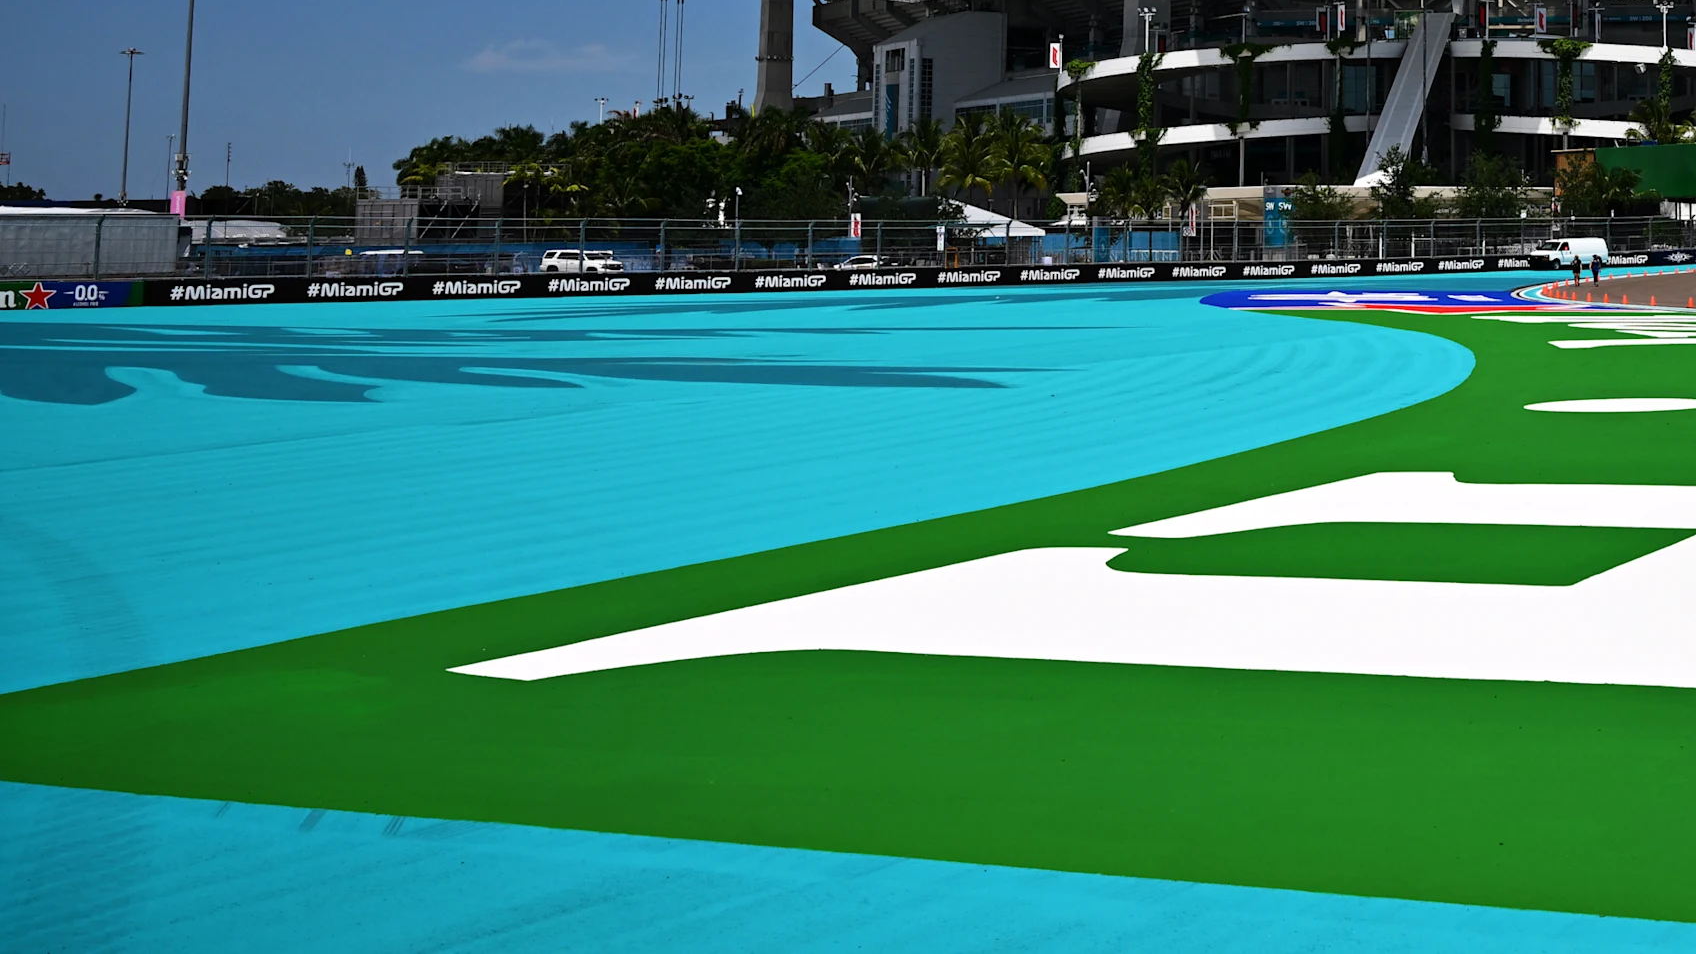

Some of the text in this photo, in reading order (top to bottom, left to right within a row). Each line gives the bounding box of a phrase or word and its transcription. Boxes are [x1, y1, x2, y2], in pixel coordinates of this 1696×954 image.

[1265, 201, 1276, 211] SW
[1243, 265, 1295, 275] #MiamiGP
[1311, 263, 1361, 274] #MiamiGP
[1376, 262, 1424, 272] #MiamiGP
[1438, 260, 1484, 270] #MiamiGP
[938, 271, 1000, 282] #MiamiGP
[1020, 269, 1080, 280] #MiamiGP
[1098, 267, 1155, 278] #MiamiGP
[1172, 266, 1226, 277] #MiamiGP
[548, 278, 630, 291] #MiamiGP
[655, 276, 731, 289] #MiamiGP
[755, 275, 826, 287] #MiamiGP
[849, 273, 916, 285] #MiamiGP
[170, 284, 274, 300] #MiamiGP
[307, 282, 403, 297] #MiamiGP
[433, 280, 521, 294] #MiamiGP
